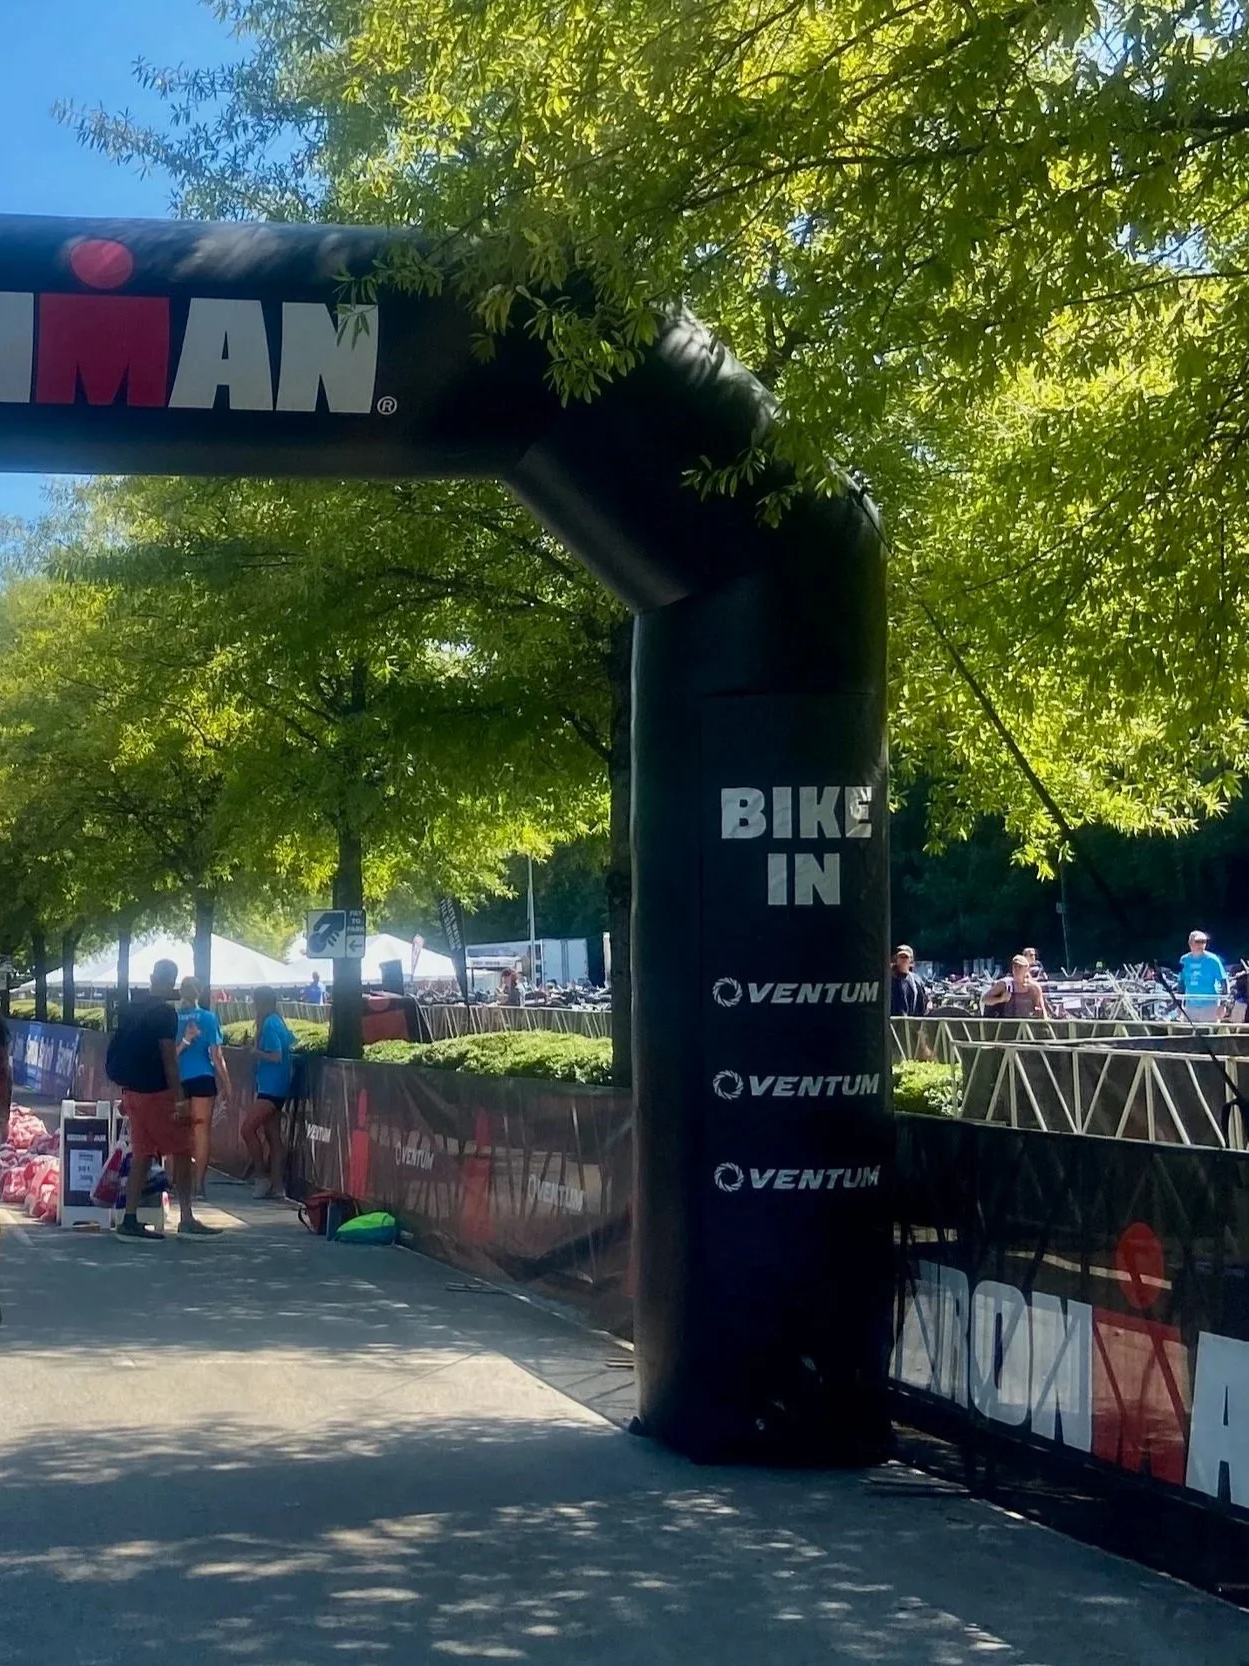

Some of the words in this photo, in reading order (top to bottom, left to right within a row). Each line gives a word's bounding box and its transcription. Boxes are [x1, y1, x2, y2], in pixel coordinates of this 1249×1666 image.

[720, 786, 872, 839] BIKE
[767, 852, 841, 906] IN
[747, 980, 879, 1004] VENTUM
[748, 1073, 880, 1097] VENTUM
[749, 1165, 880, 1190] VENTUM
